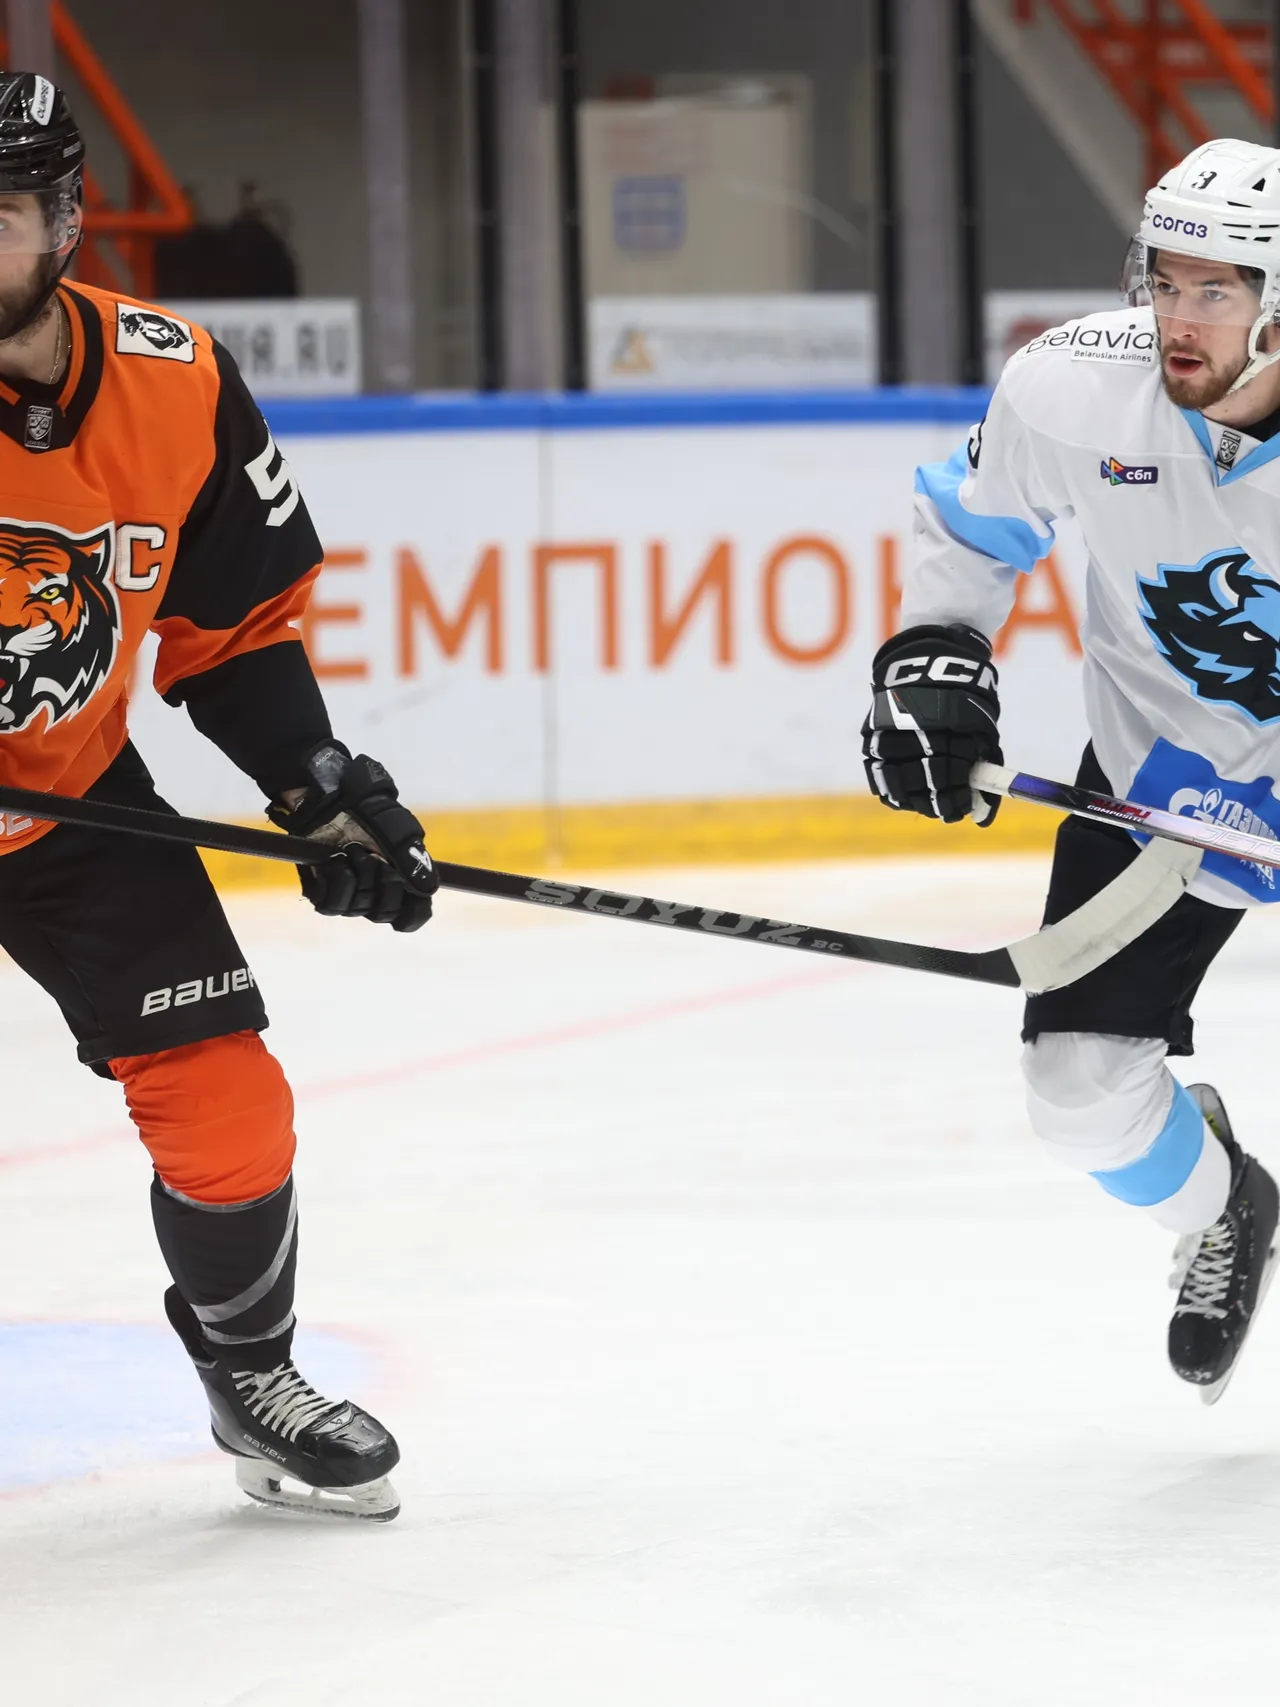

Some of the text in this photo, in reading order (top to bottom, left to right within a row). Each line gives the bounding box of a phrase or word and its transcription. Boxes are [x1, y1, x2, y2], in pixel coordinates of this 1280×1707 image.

[1026, 324, 1155, 354] Belavia
[1074, 350, 1151, 363] Belarusian Airlines
[114, 523, 167, 591] C
